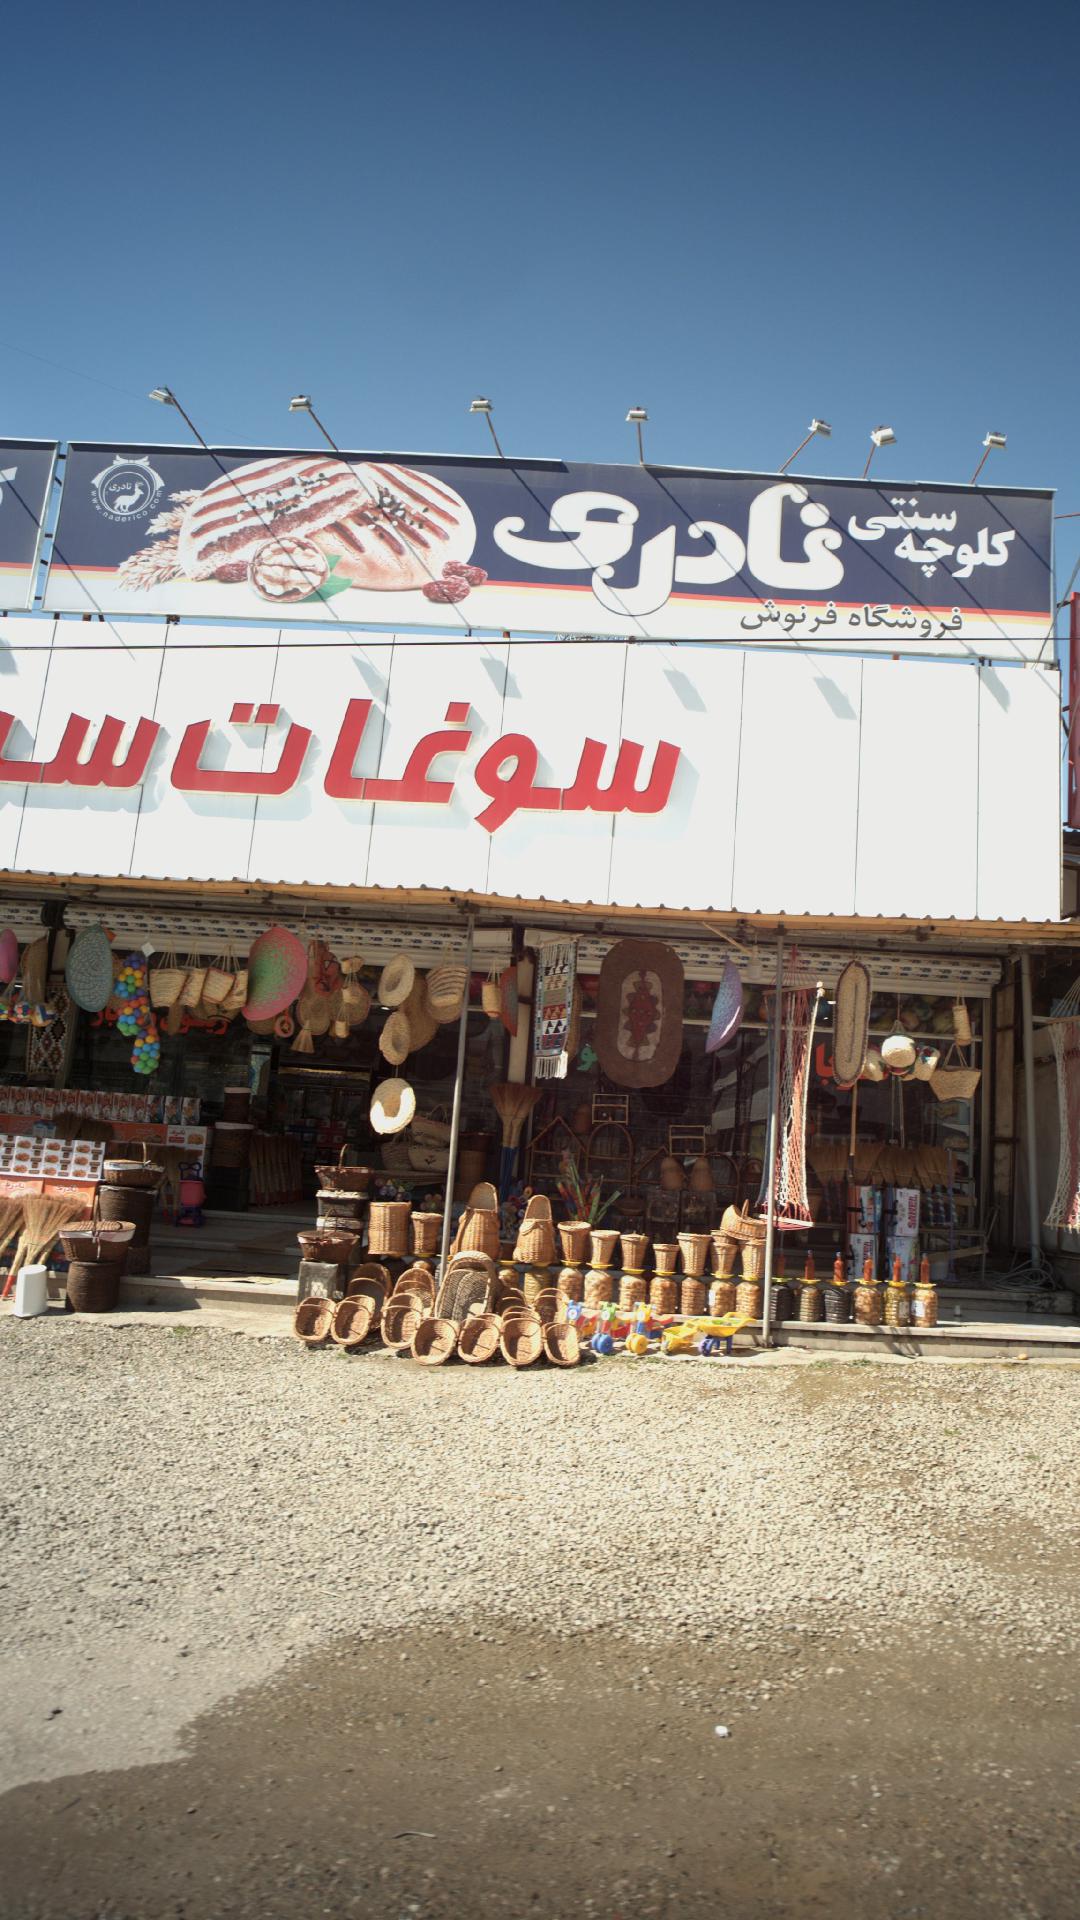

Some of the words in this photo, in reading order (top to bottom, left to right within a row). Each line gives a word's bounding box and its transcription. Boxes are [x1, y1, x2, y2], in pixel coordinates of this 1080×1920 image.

[848, 497, 957, 541] سنتی
[493, 483, 844, 617] نادری
[894, 527, 1016, 578] کلوچه
[740, 602, 838, 634] فرنوش
[848, 606, 963, 639] فروشگاه
[170, 698, 681, 834] سوغات
